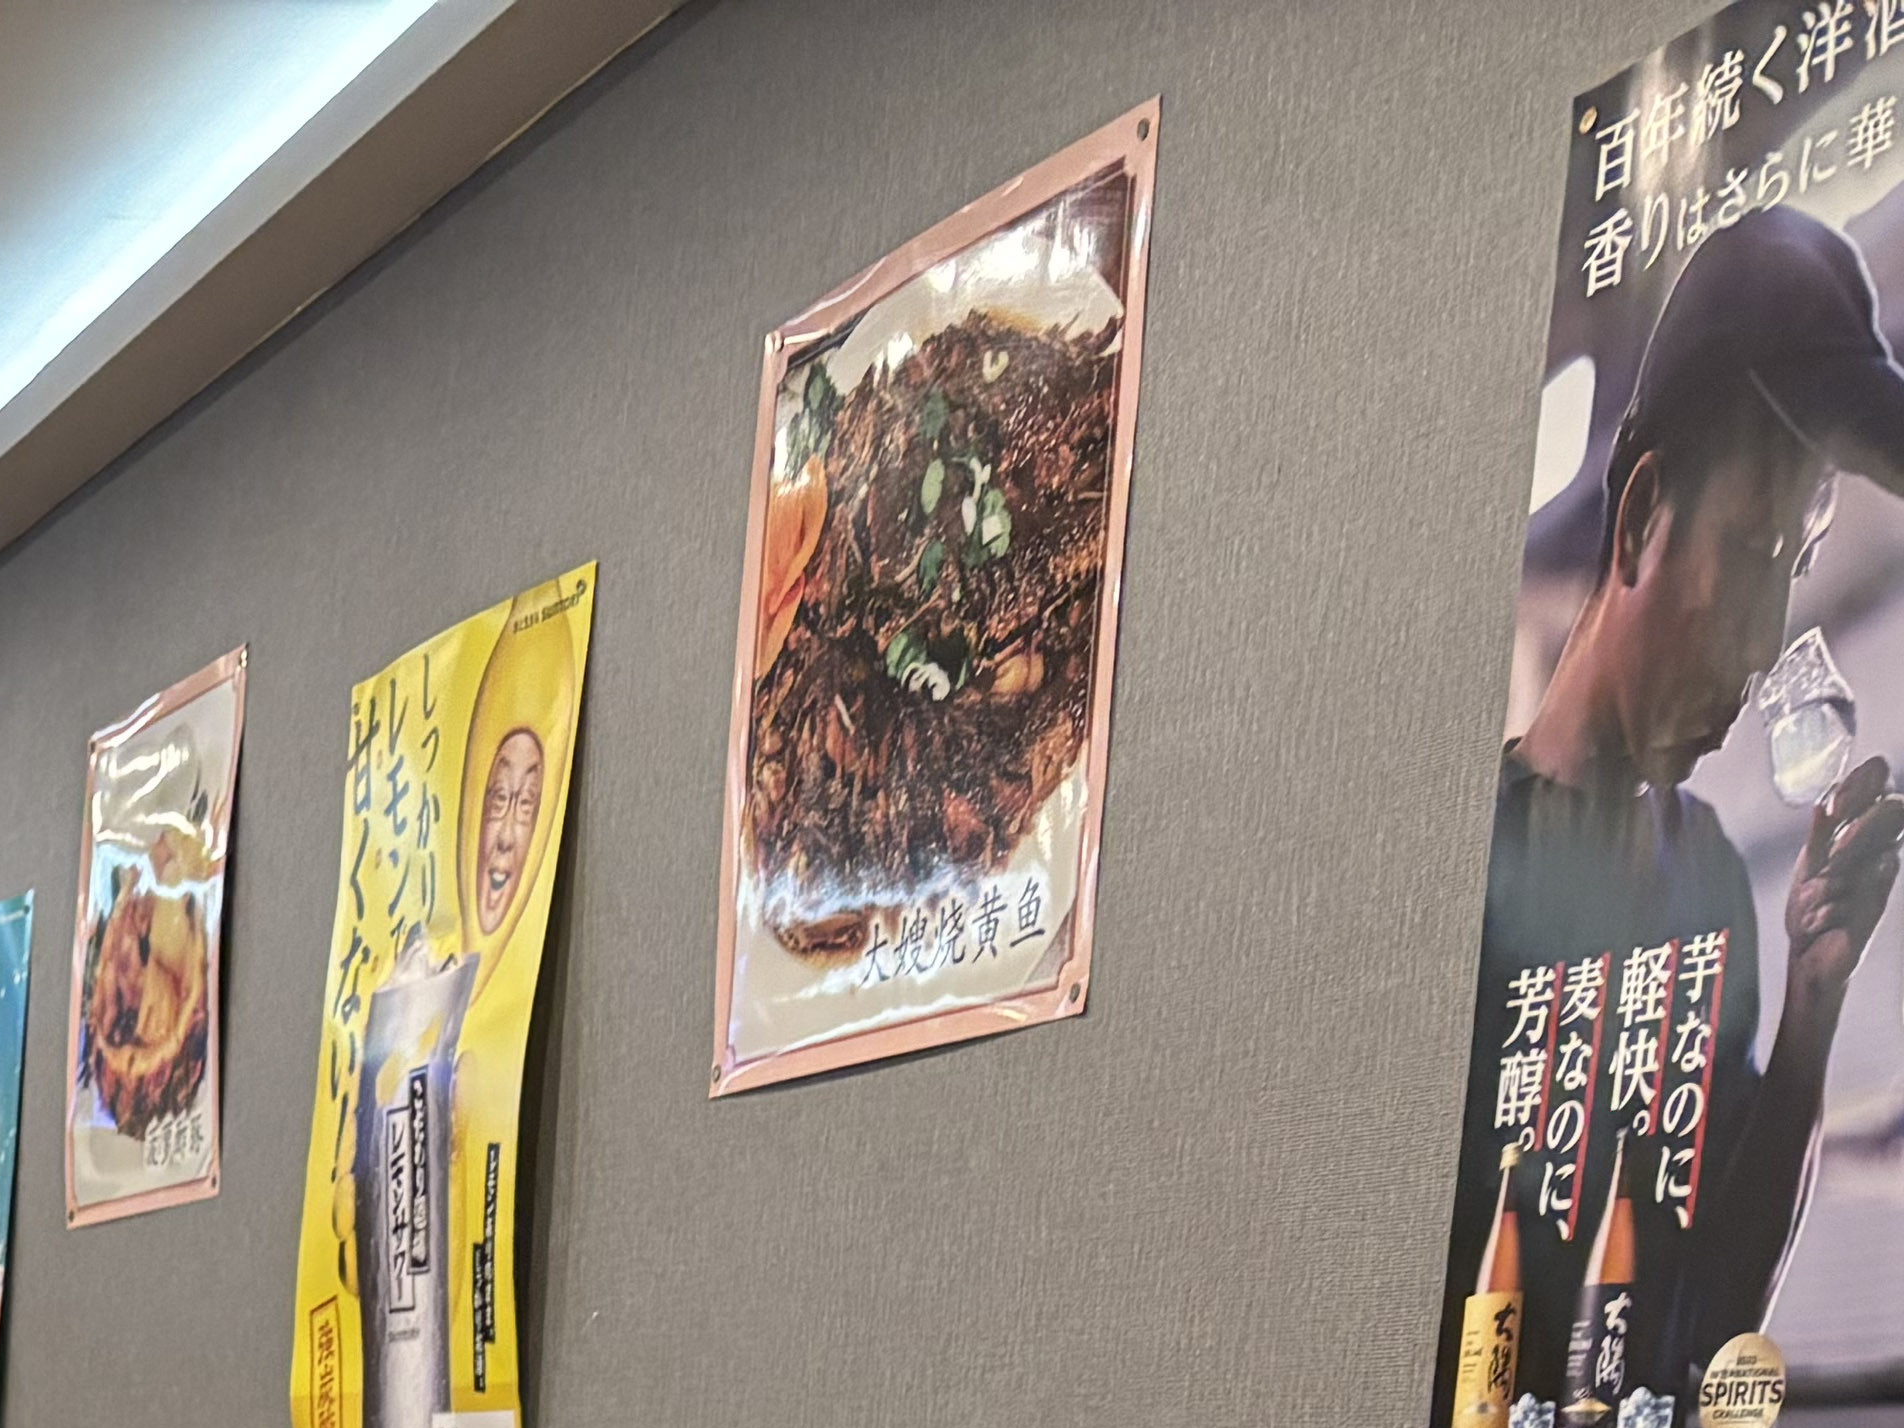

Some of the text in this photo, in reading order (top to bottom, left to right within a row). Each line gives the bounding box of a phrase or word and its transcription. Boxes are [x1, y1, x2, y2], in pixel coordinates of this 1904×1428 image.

[1581, 96, 1897, 298] 香りはさらに華
[417, 653, 441, 924] しっかり
[1494, 966, 1556, 1151] 芳醇。
[1539, 957, 1604, 1241] 麦なのに、
[1608, 942, 1672, 1136] 軽快。
[1655, 931, 1725, 1229] 芋なのに、
[1700, 1380, 1784, 1407] SPIRITS
